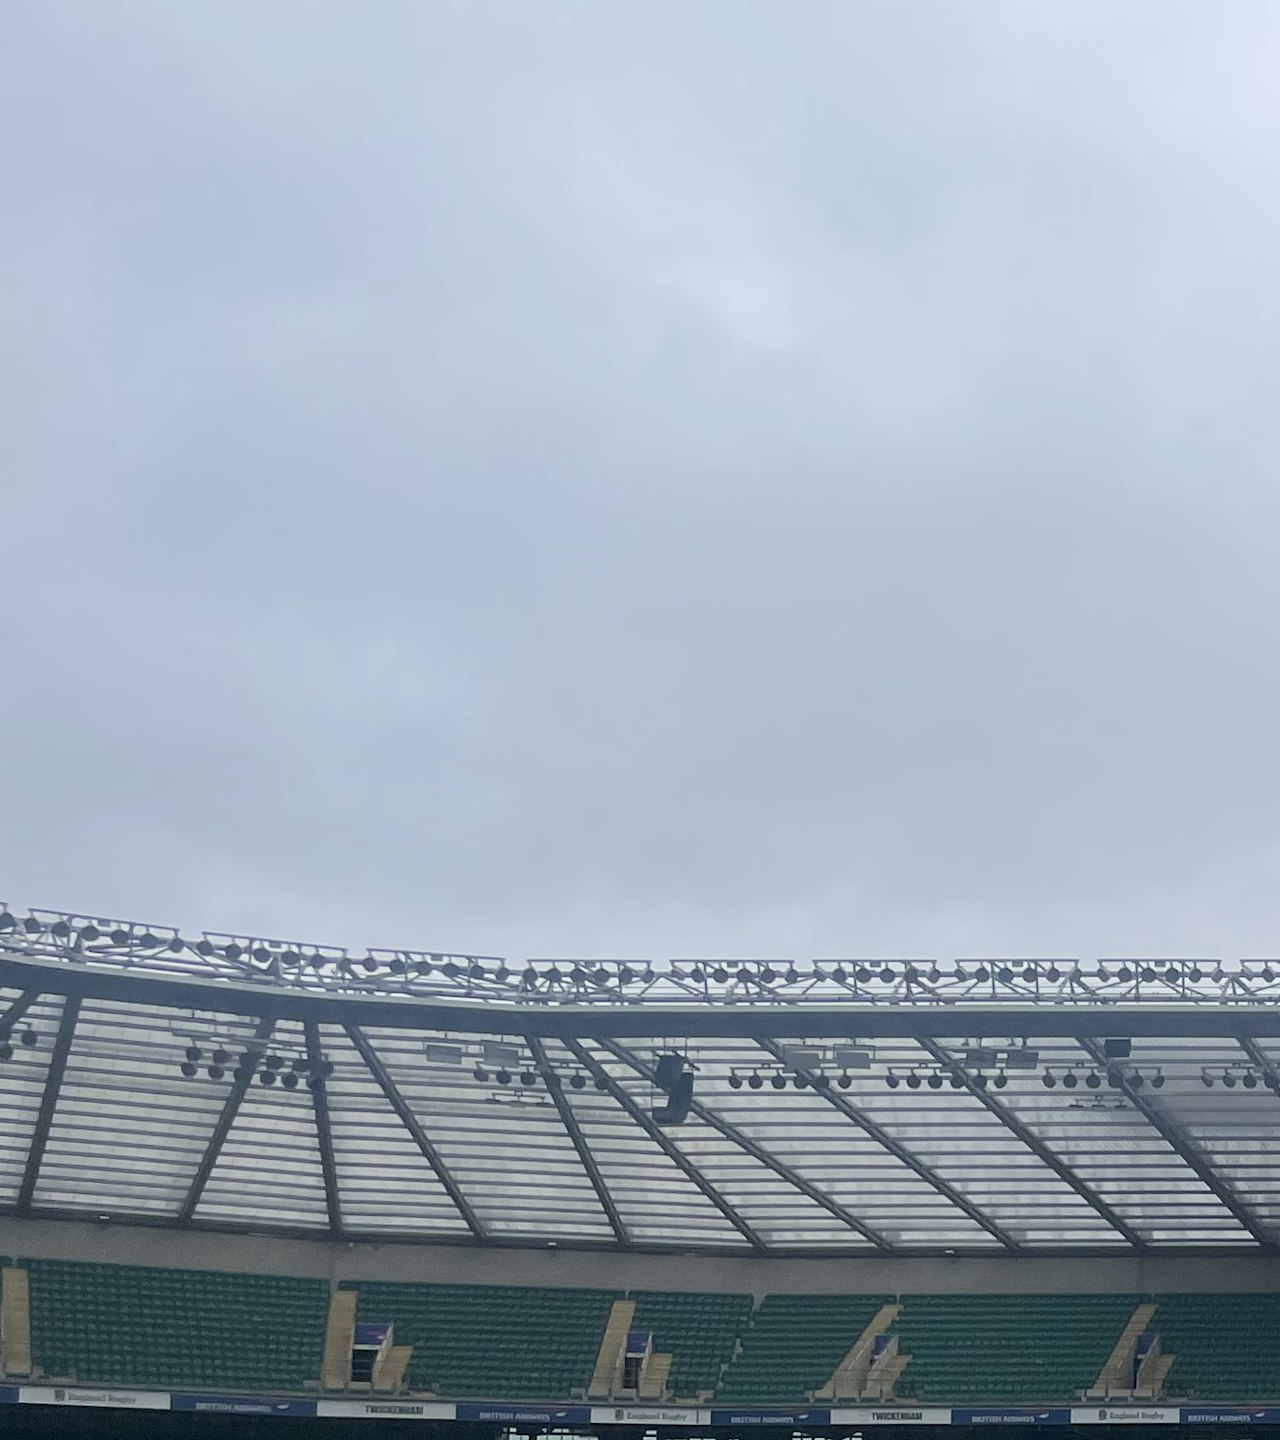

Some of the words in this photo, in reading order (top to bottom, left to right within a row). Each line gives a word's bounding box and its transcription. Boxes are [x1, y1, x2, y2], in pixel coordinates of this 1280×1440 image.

[626, 1411, 661, 1420] England
[662, 1413, 688, 1421] Rugby
[872, 1412, 923, 1421] TWICKENHAM
[1109, 1411, 1140, 1420] England
[1142, 1412, 1164, 1420] Rugby
